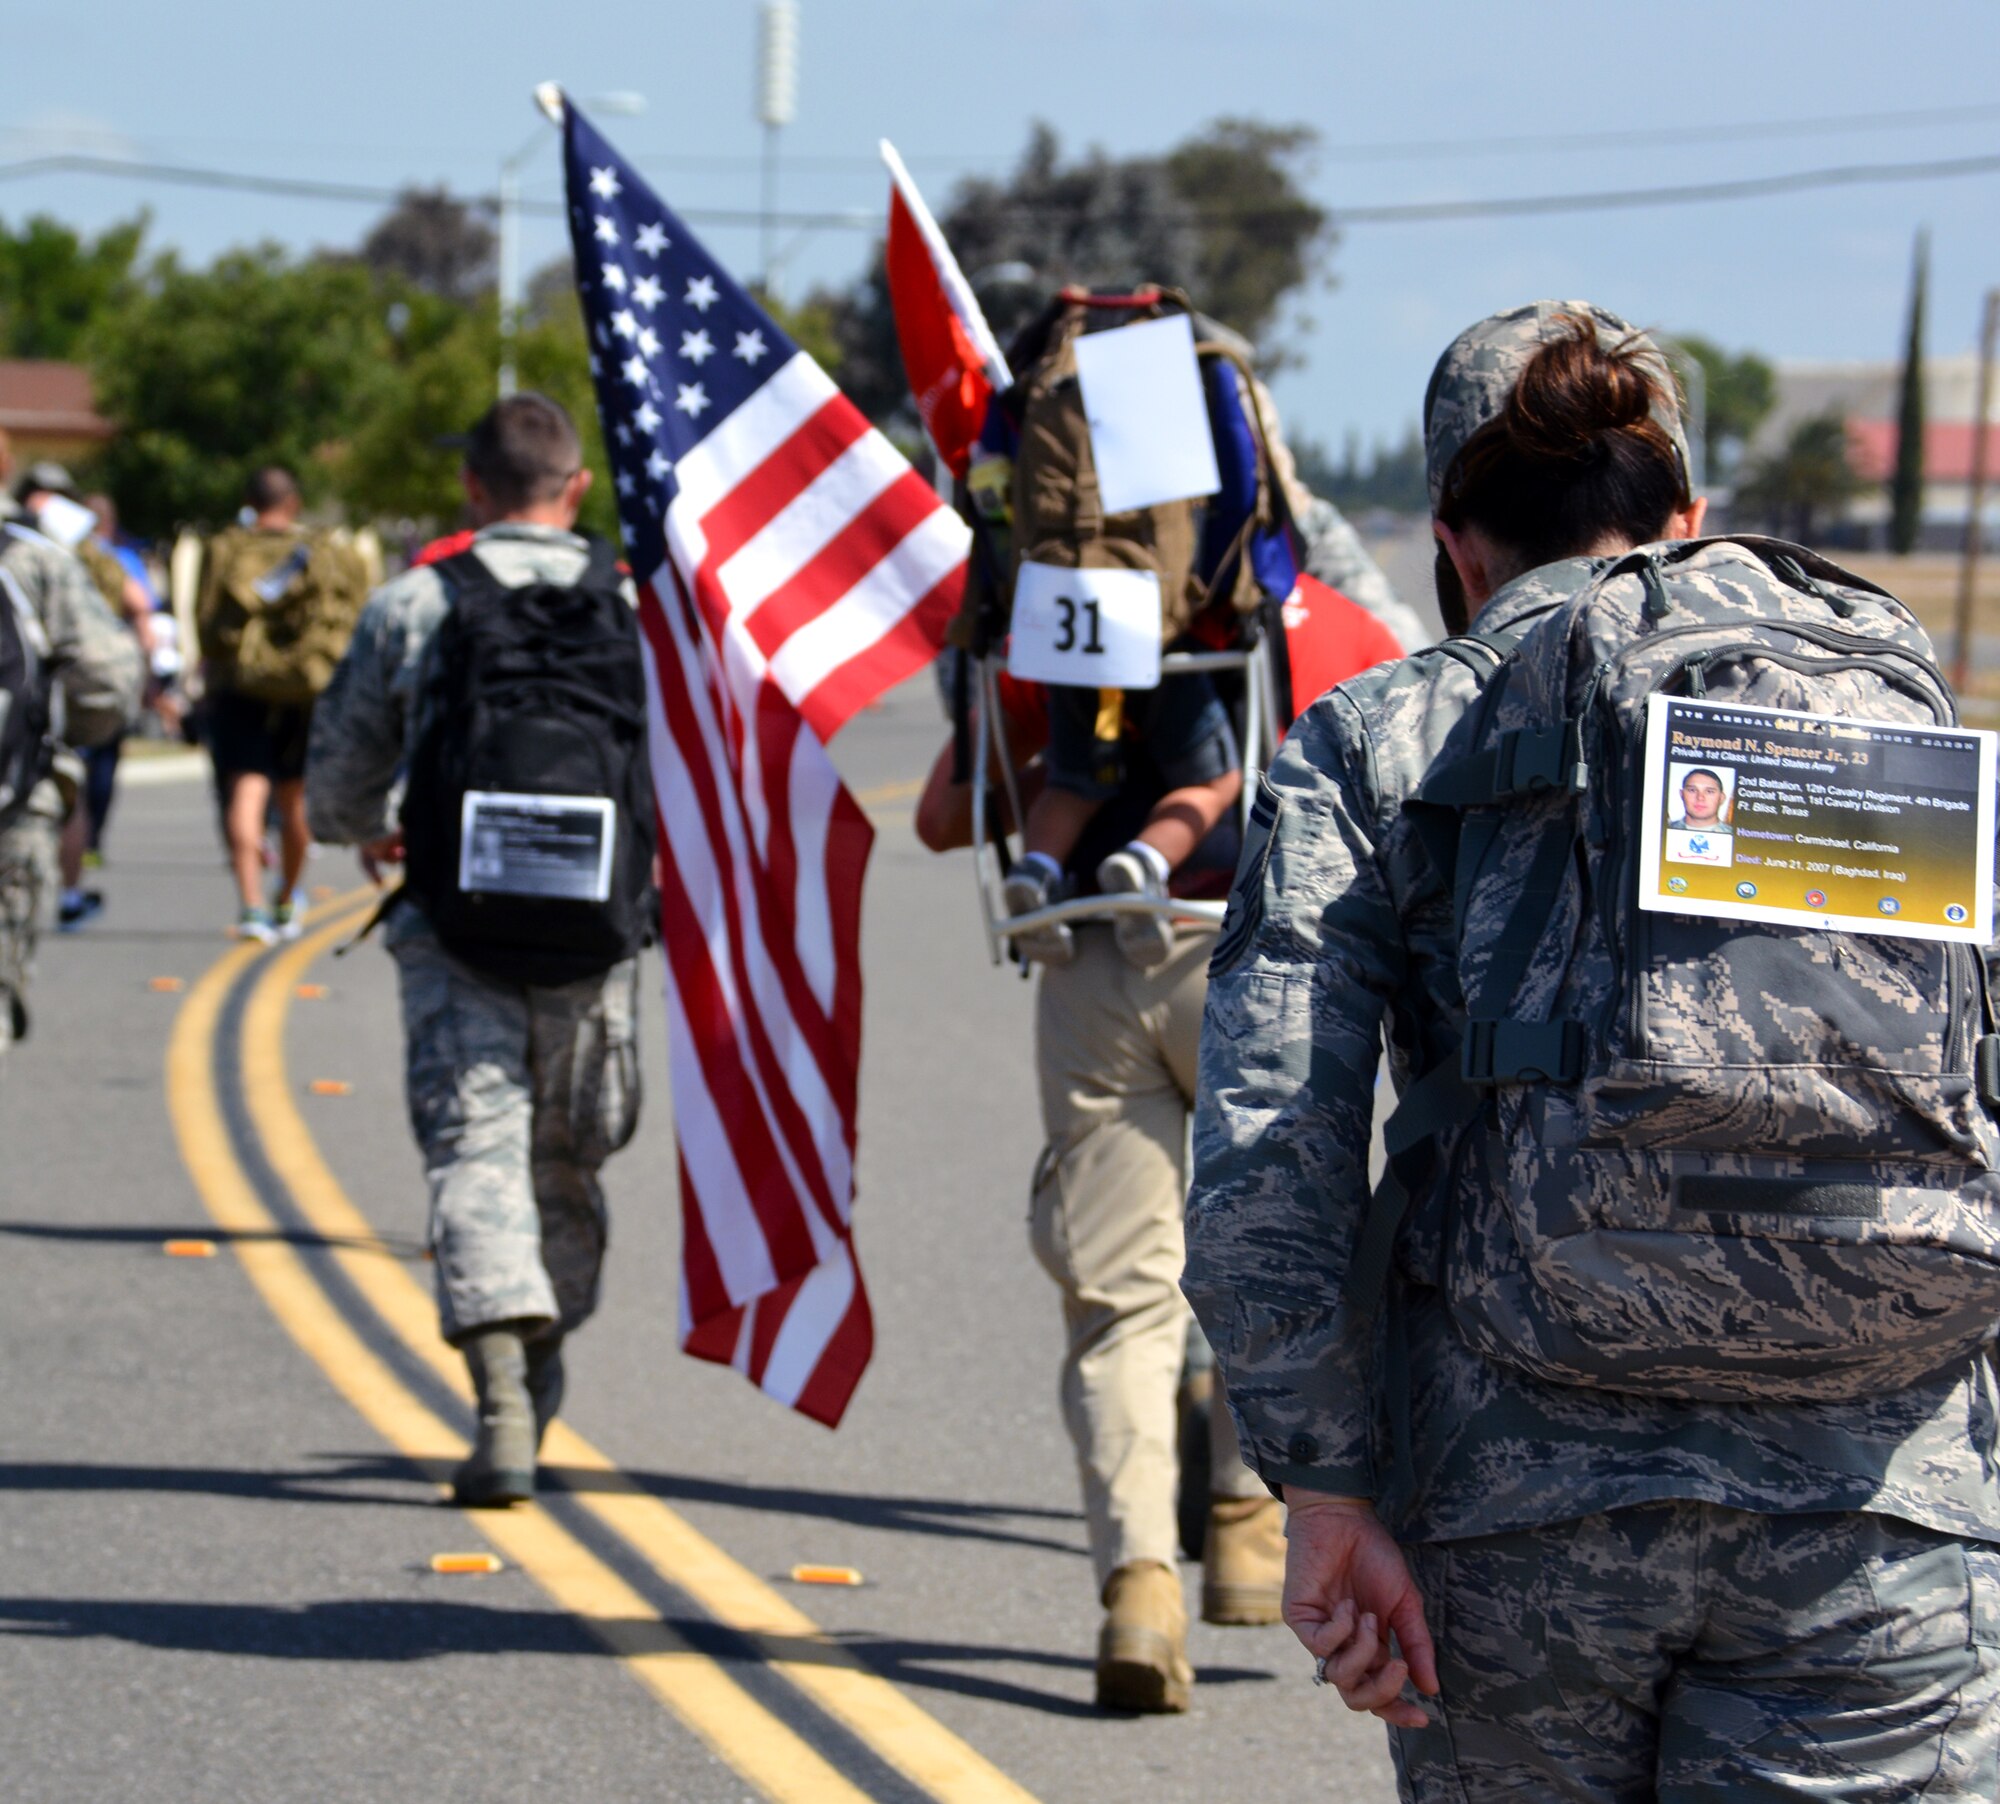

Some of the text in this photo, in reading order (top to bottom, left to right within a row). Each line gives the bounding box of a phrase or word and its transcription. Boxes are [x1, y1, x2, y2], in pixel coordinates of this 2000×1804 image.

[1054, 595, 1105, 654] 31
[1671, 746, 1704, 758] Private
[1706, 750, 1719, 760] 1st
[1751, 754, 1781, 766] United
[1782, 758, 1810, 769] States
[1811, 761, 1837, 774] Army
[1672, 730, 1742, 750] Raymond
[1744, 738, 1762, 753] N.
[1764, 741, 1822, 760] Spencer
[1851, 751, 1869, 765] 23
[1738, 775, 1757, 786] 2nd
[1805, 783, 1826, 794] 12th
[1827, 785, 1864, 800] Cavalry
[1915, 796, 1931, 806] 4th
[1932, 797, 1970, 811] Brigade
[1738, 787, 1776, 800] Combat
[1809, 795, 1824, 806] 1st
[1824, 796, 1861, 811] Cavalry
[1862, 801, 1901, 814] Division
[1781, 804, 1810, 817] Texas
[1736, 827, 1794, 842] Hometown:
[1853, 840, 1899, 854] California
[1736, 853, 1762, 865] Died:
[1763, 857, 1787, 869] June
[1806, 862, 1830, 873] 2007
[1883, 871, 1907, 883] Iraq)
